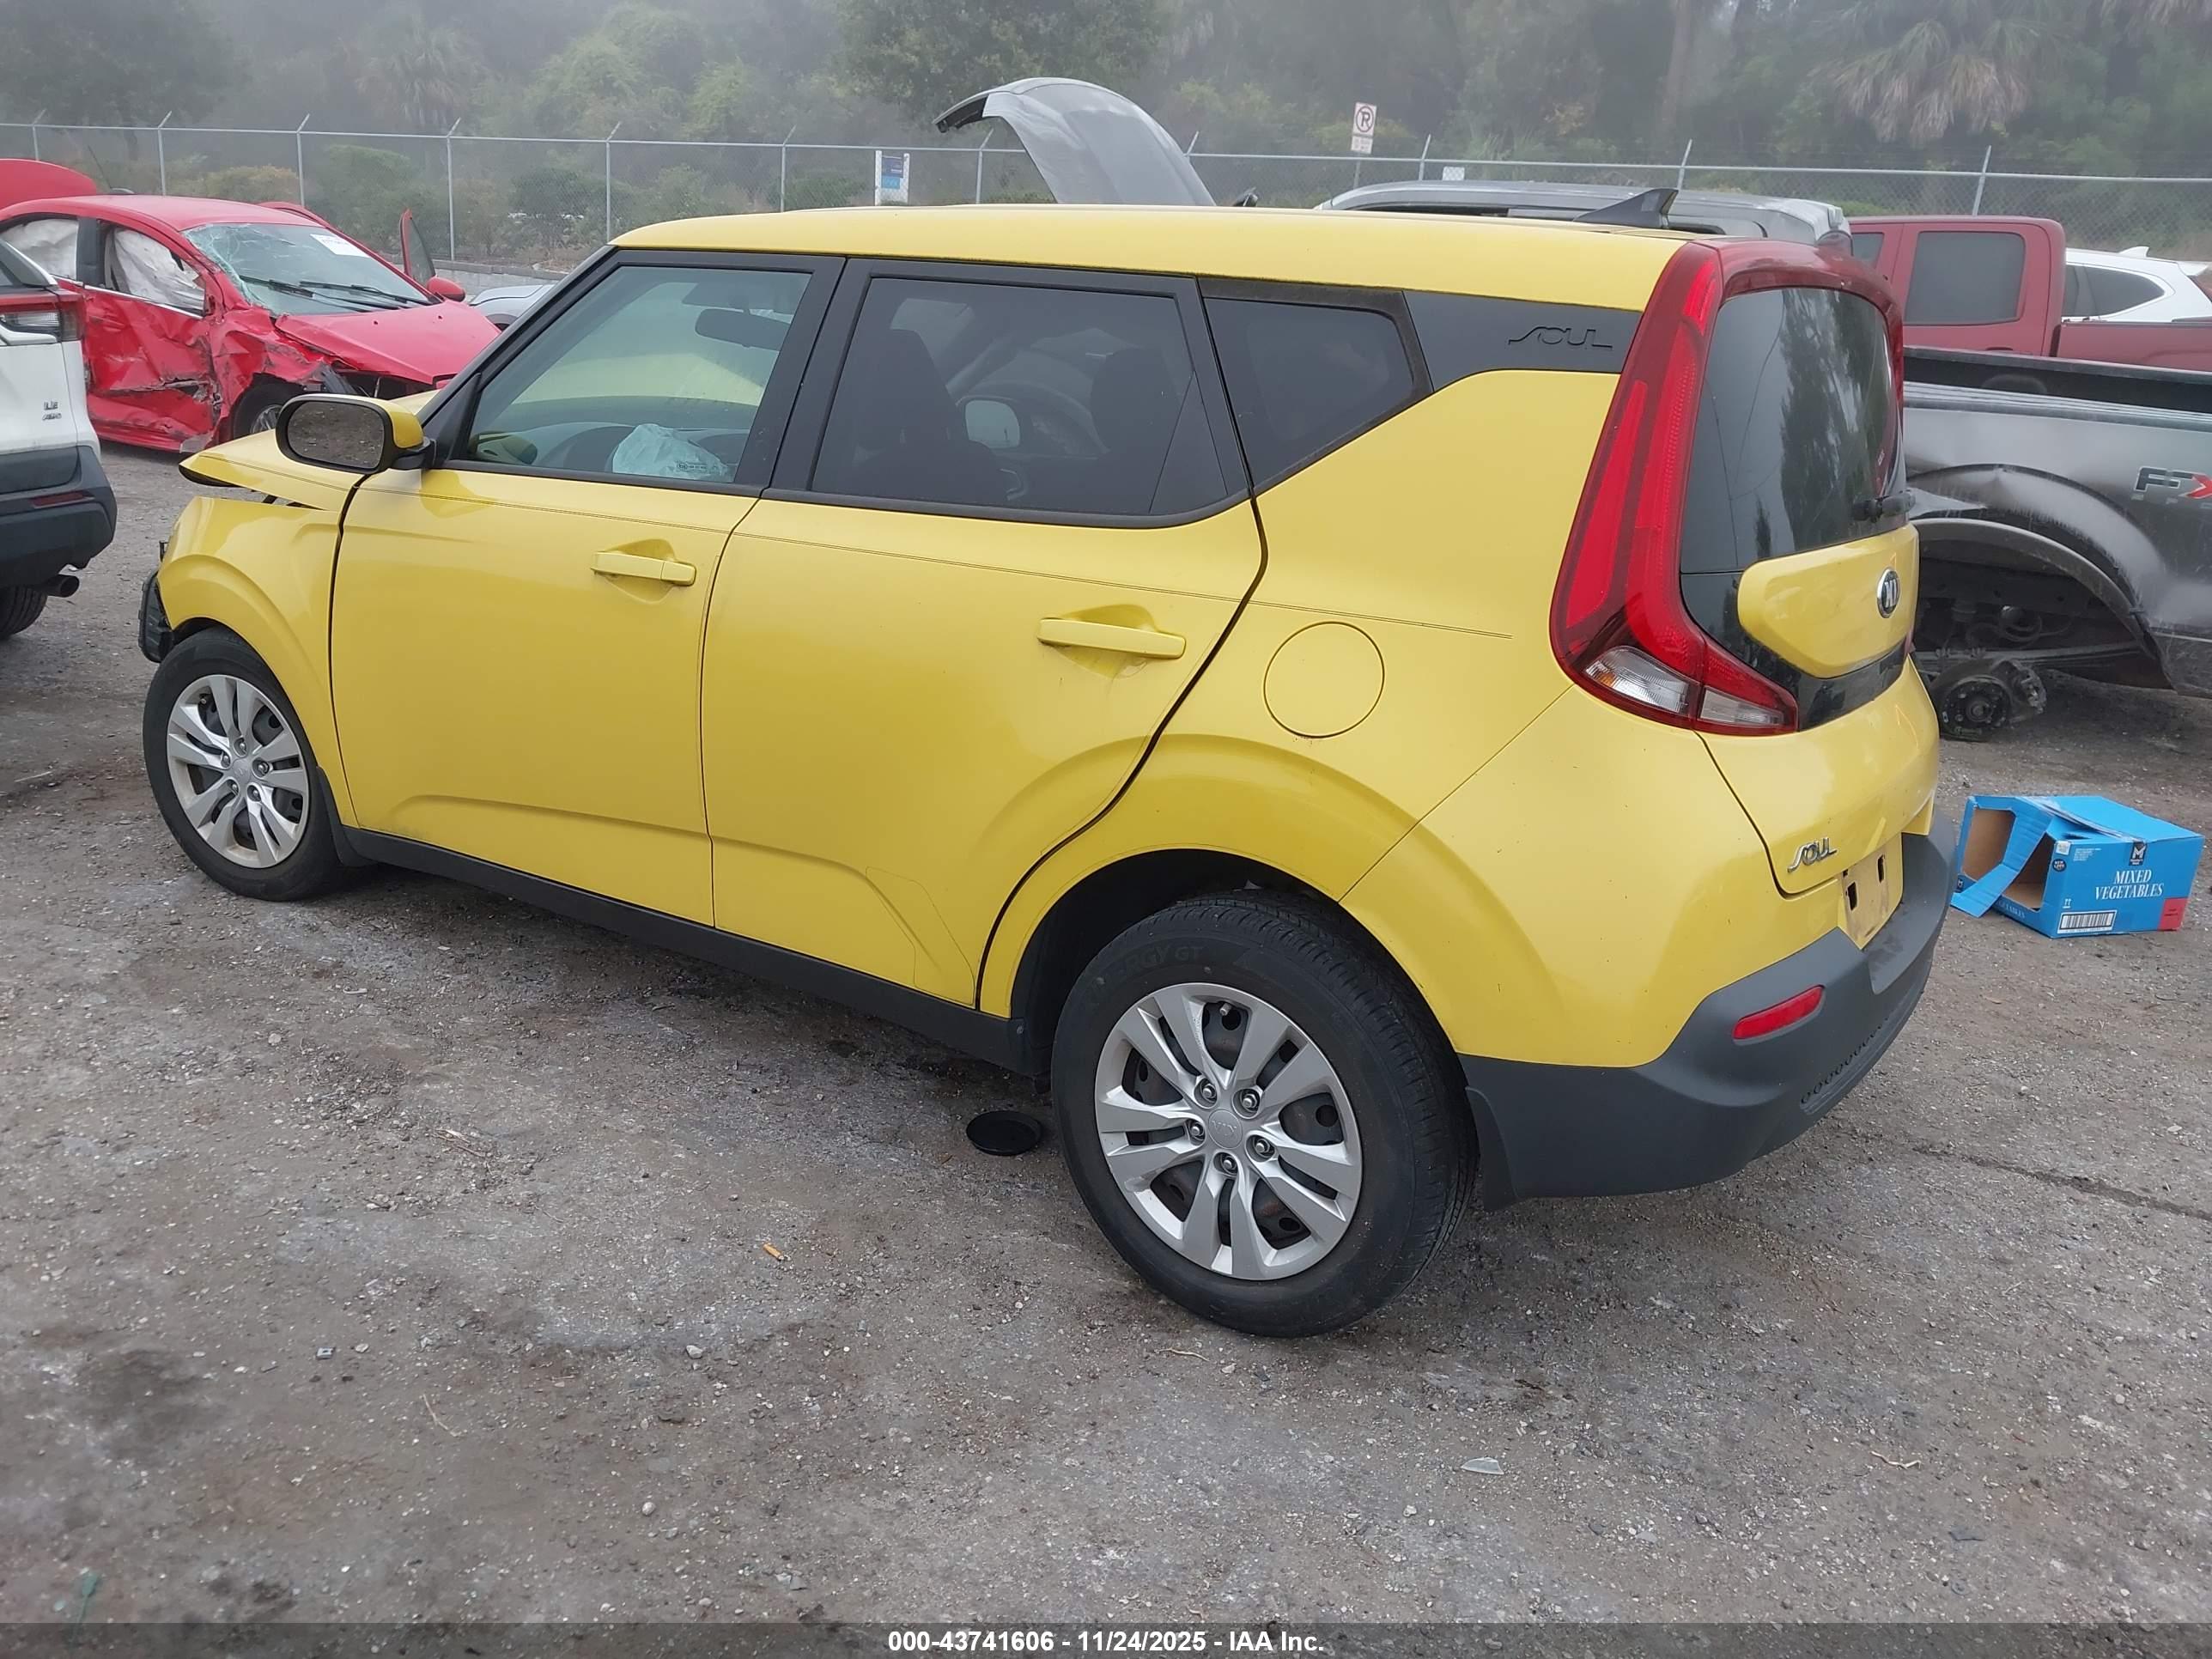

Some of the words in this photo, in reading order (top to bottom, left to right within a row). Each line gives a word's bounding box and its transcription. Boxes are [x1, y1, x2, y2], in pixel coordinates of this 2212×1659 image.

[1507, 326, 1613, 348] SOUL
[1787, 837, 1838, 872] SOUL
[2113, 870, 2152, 884] MIXED
[2095, 883, 2164, 900] VEGETABLES
